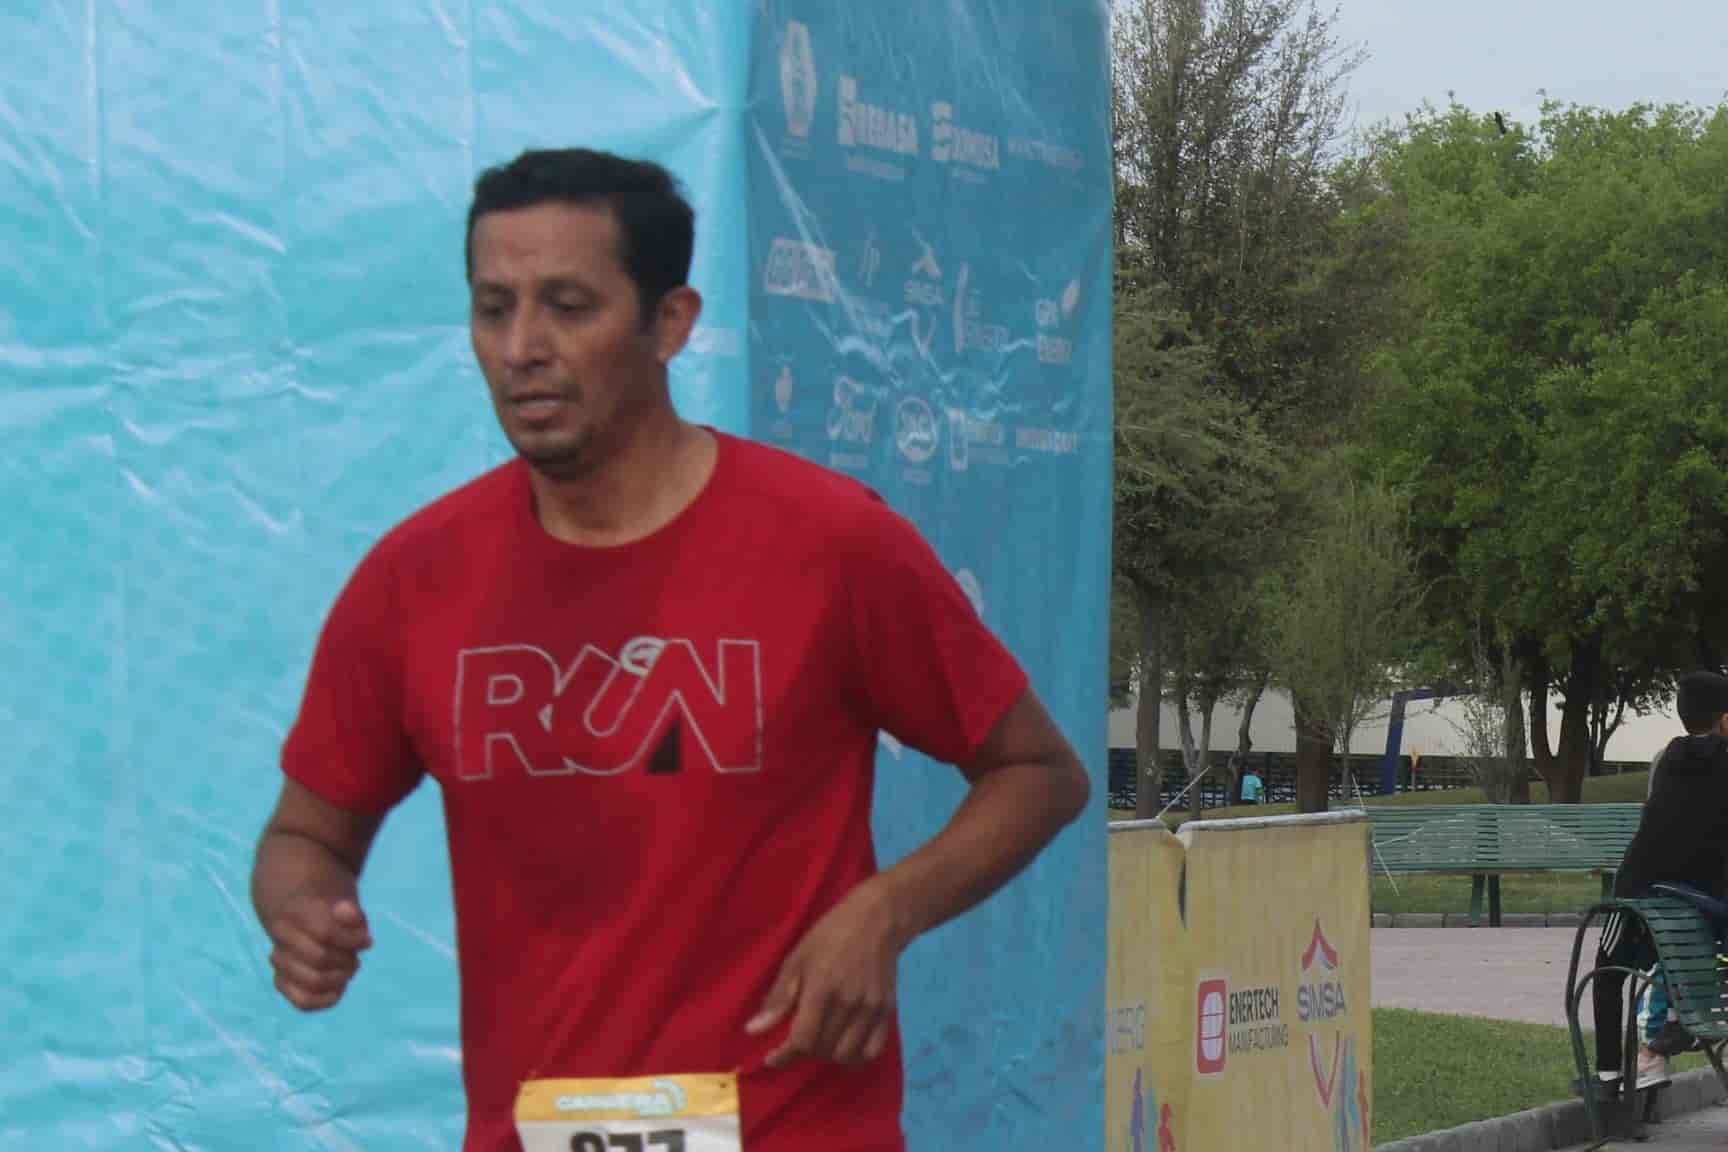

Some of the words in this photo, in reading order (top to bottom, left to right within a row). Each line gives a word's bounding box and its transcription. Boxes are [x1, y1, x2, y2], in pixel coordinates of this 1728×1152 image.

[454, 637, 763, 781] RUN
[1228, 985, 1281, 1025] ENERTECH
[1296, 981, 1346, 1022] SIMSA
